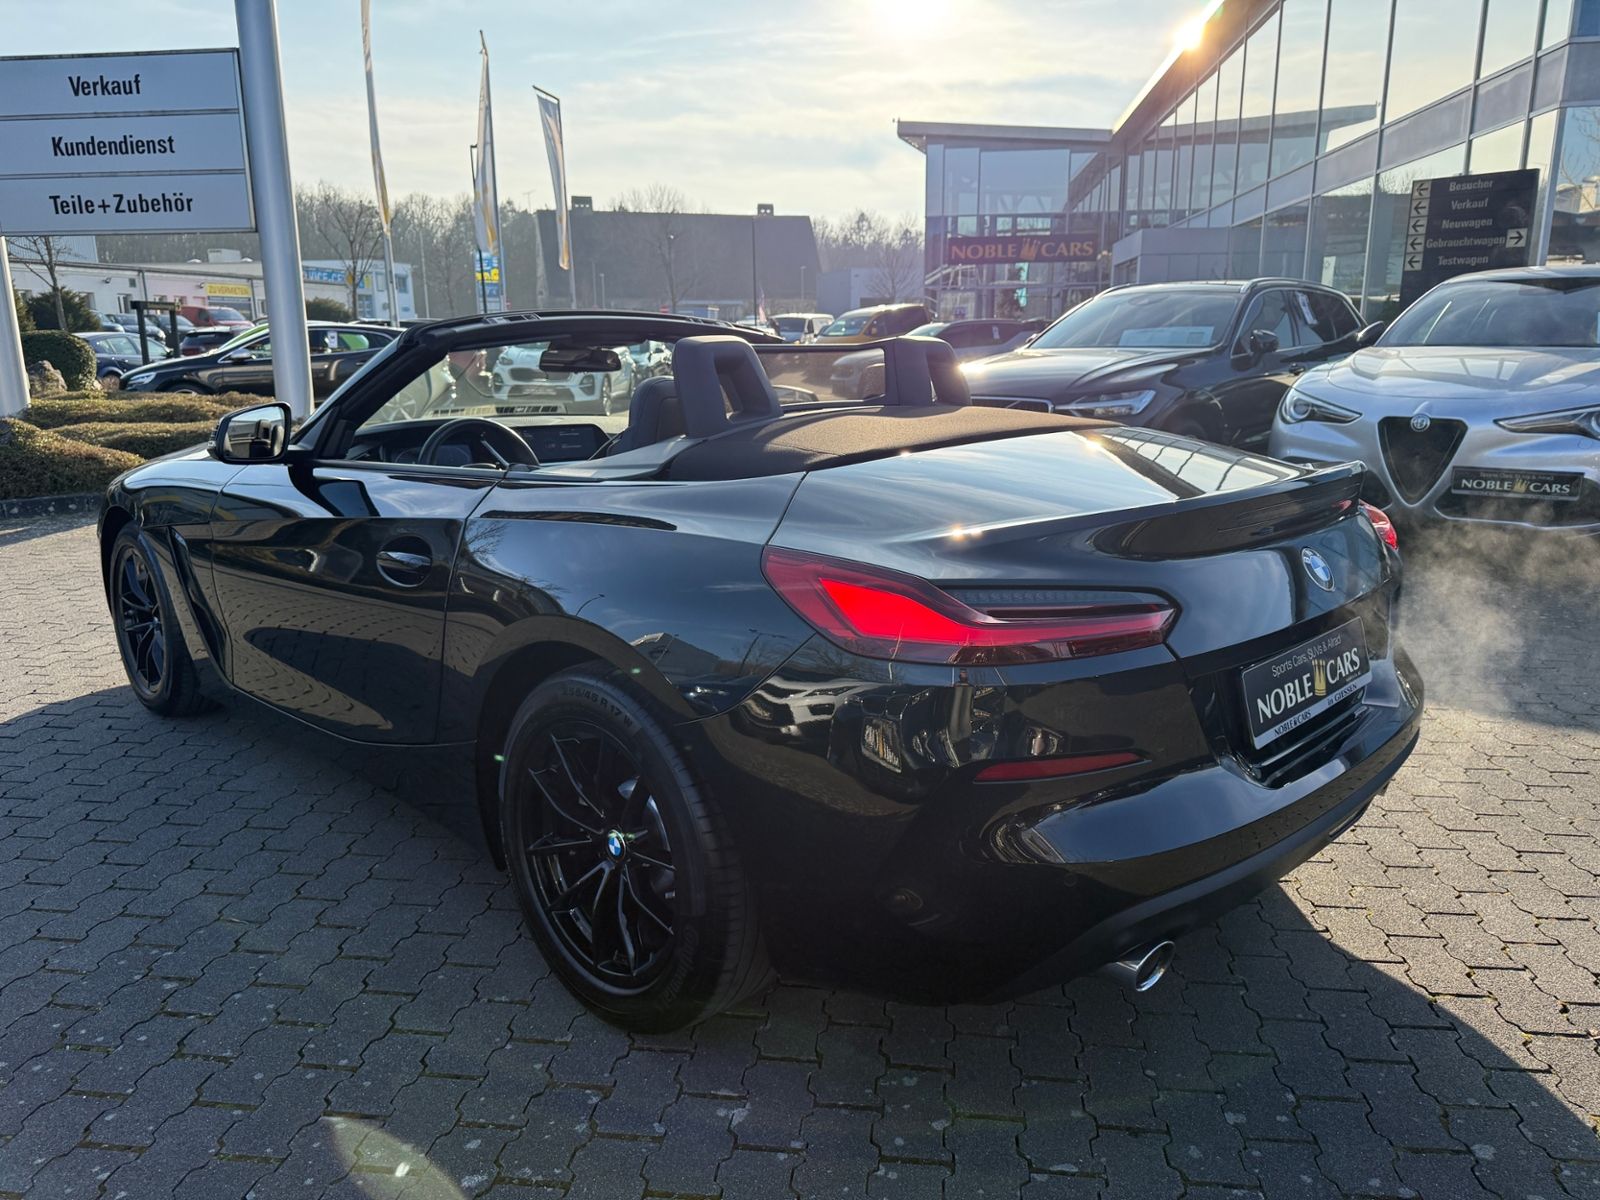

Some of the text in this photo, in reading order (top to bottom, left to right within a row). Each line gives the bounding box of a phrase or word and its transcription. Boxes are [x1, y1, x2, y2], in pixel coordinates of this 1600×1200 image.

[68, 74, 141, 97] Verkauf
[51, 135, 175, 157] Kundendienst
[1449, 180, 1493, 192] Besucher
[49, 193, 193, 215] Teile+Zubehör
[1451, 198, 1488, 210] Verkauf
[1442, 218, 1493, 230] Neuwagen
[951, 240, 1094, 260] NOBLE CARS
[1426, 235, 1506, 249] Gebrauchtwagen
[1438, 255, 1489, 267] Testwagen
[1460, 478, 1571, 494] NOBLE CARS
[1271, 660, 1293, 678] Sports
[1256, 647, 1360, 723] NOBLE CARS
[1274, 719, 1294, 737] NOBLE
[1296, 709, 1312, 725] CARS
